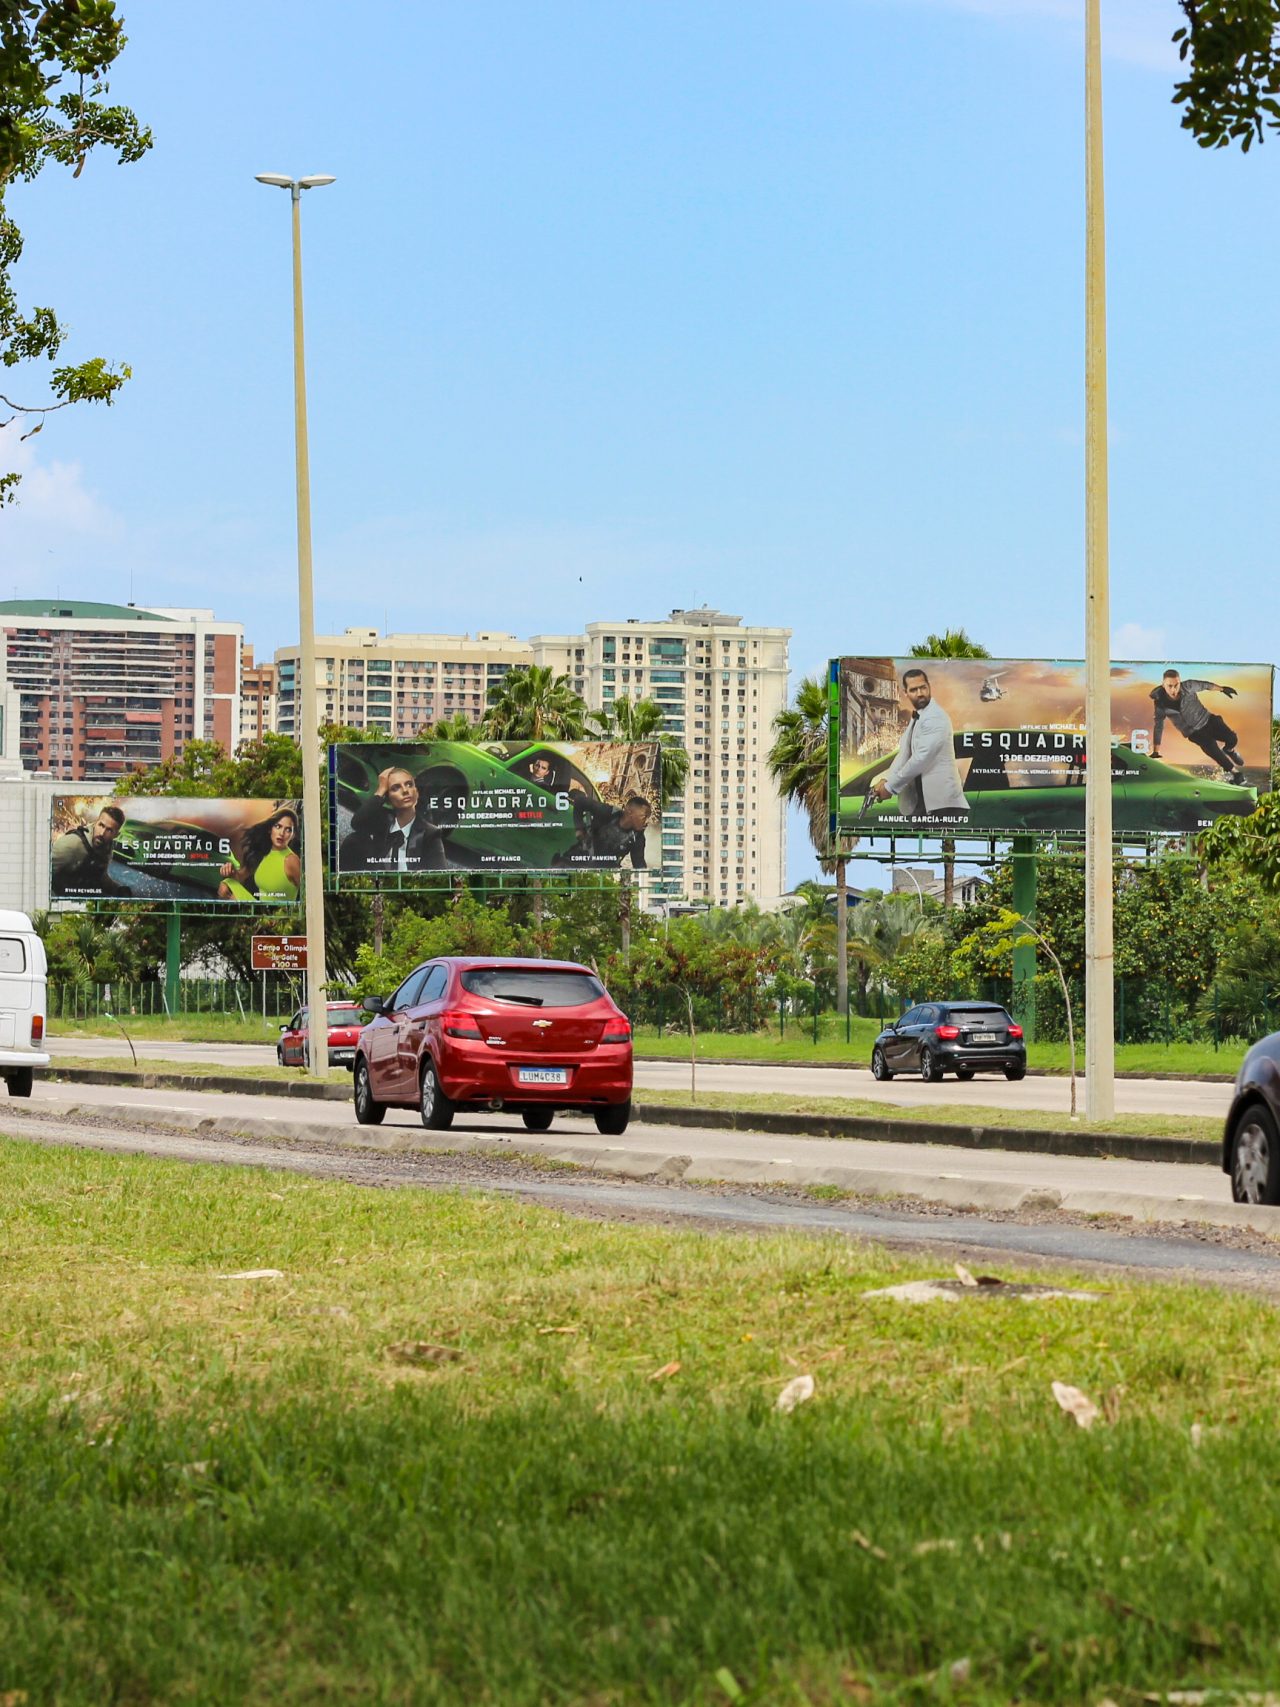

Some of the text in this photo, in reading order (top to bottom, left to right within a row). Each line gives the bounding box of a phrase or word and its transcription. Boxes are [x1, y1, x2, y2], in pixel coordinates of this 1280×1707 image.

[1049, 723, 1077, 731] MICHAEL
[1131, 729, 1149, 754] 6
[1000, 754, 1010, 763] 13
[1011, 755, 1023, 763] DE
[1024, 754, 1073, 764] DEZEMBRO
[430, 791, 570, 811] ESQUADRÃO 6
[878, 815, 969, 824] MANUEL GARCÍA-RULFO
[1197, 819, 1213, 827] BEN
[121, 838, 231, 854] ESQUADRÃO 6
